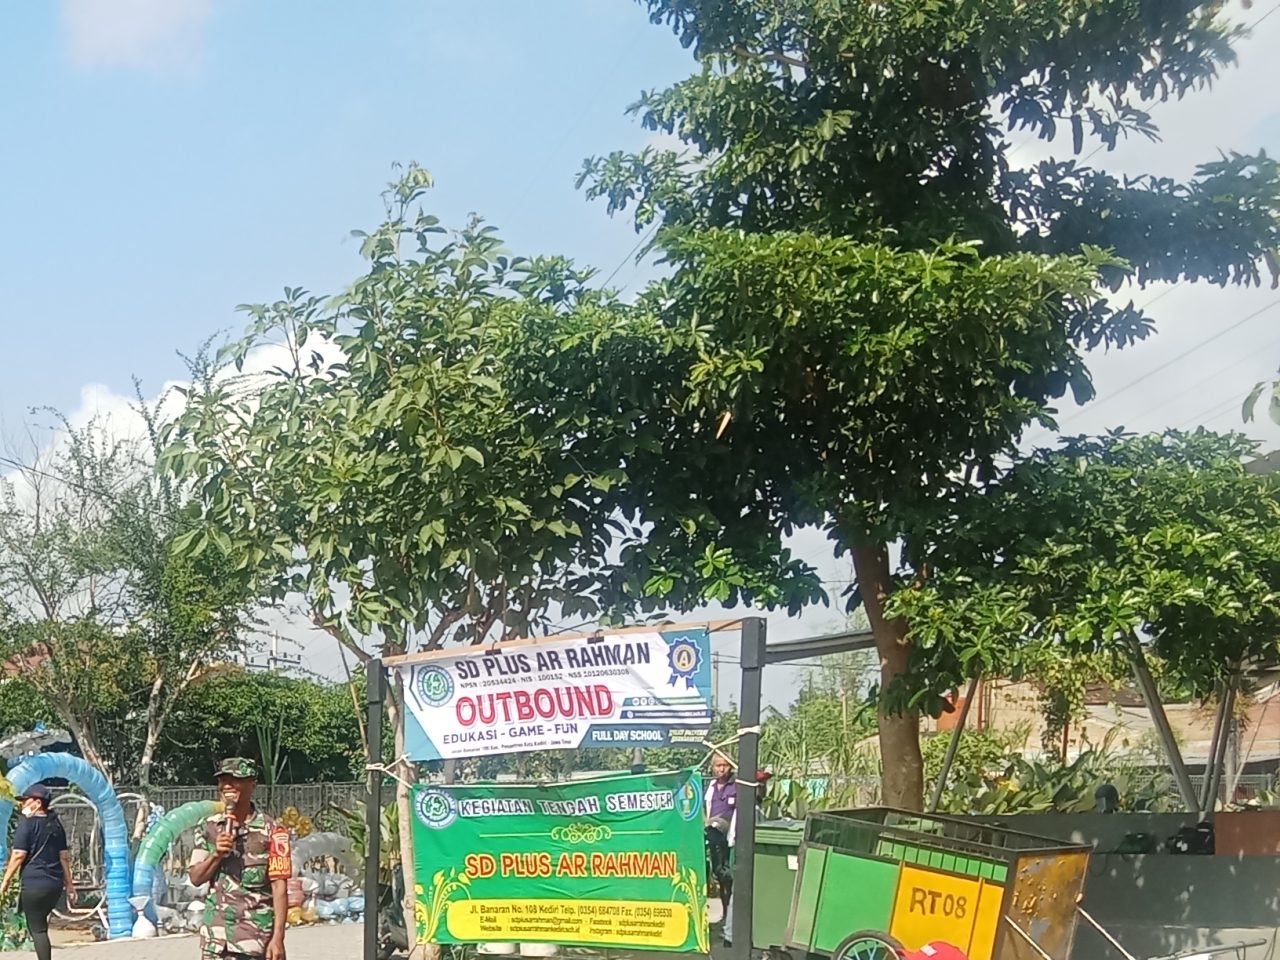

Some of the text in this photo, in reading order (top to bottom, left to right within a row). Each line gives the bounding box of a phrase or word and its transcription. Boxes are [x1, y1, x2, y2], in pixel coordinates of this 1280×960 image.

[455, 642, 651, 680] SD PLUS AR RAHMAN
[456, 684, 613, 727] OUTBOUND
[443, 730, 498, 744] EDUKASI
[509, 725, 545, 738] GAME
[554, 723, 578, 734] FUN
[592, 730, 613, 740] FULL
[614, 730, 629, 740] DAY
[630, 730, 663, 741] SCHOOL
[460, 798, 534, 816] KEGIATAN
[539, 796, 601, 815] TENGAH
[607, 790, 674, 812] SEMESTER
[465, 853, 677, 878] SD PLUS AR RAHMAN
[480, 904, 510, 914] Banaran
